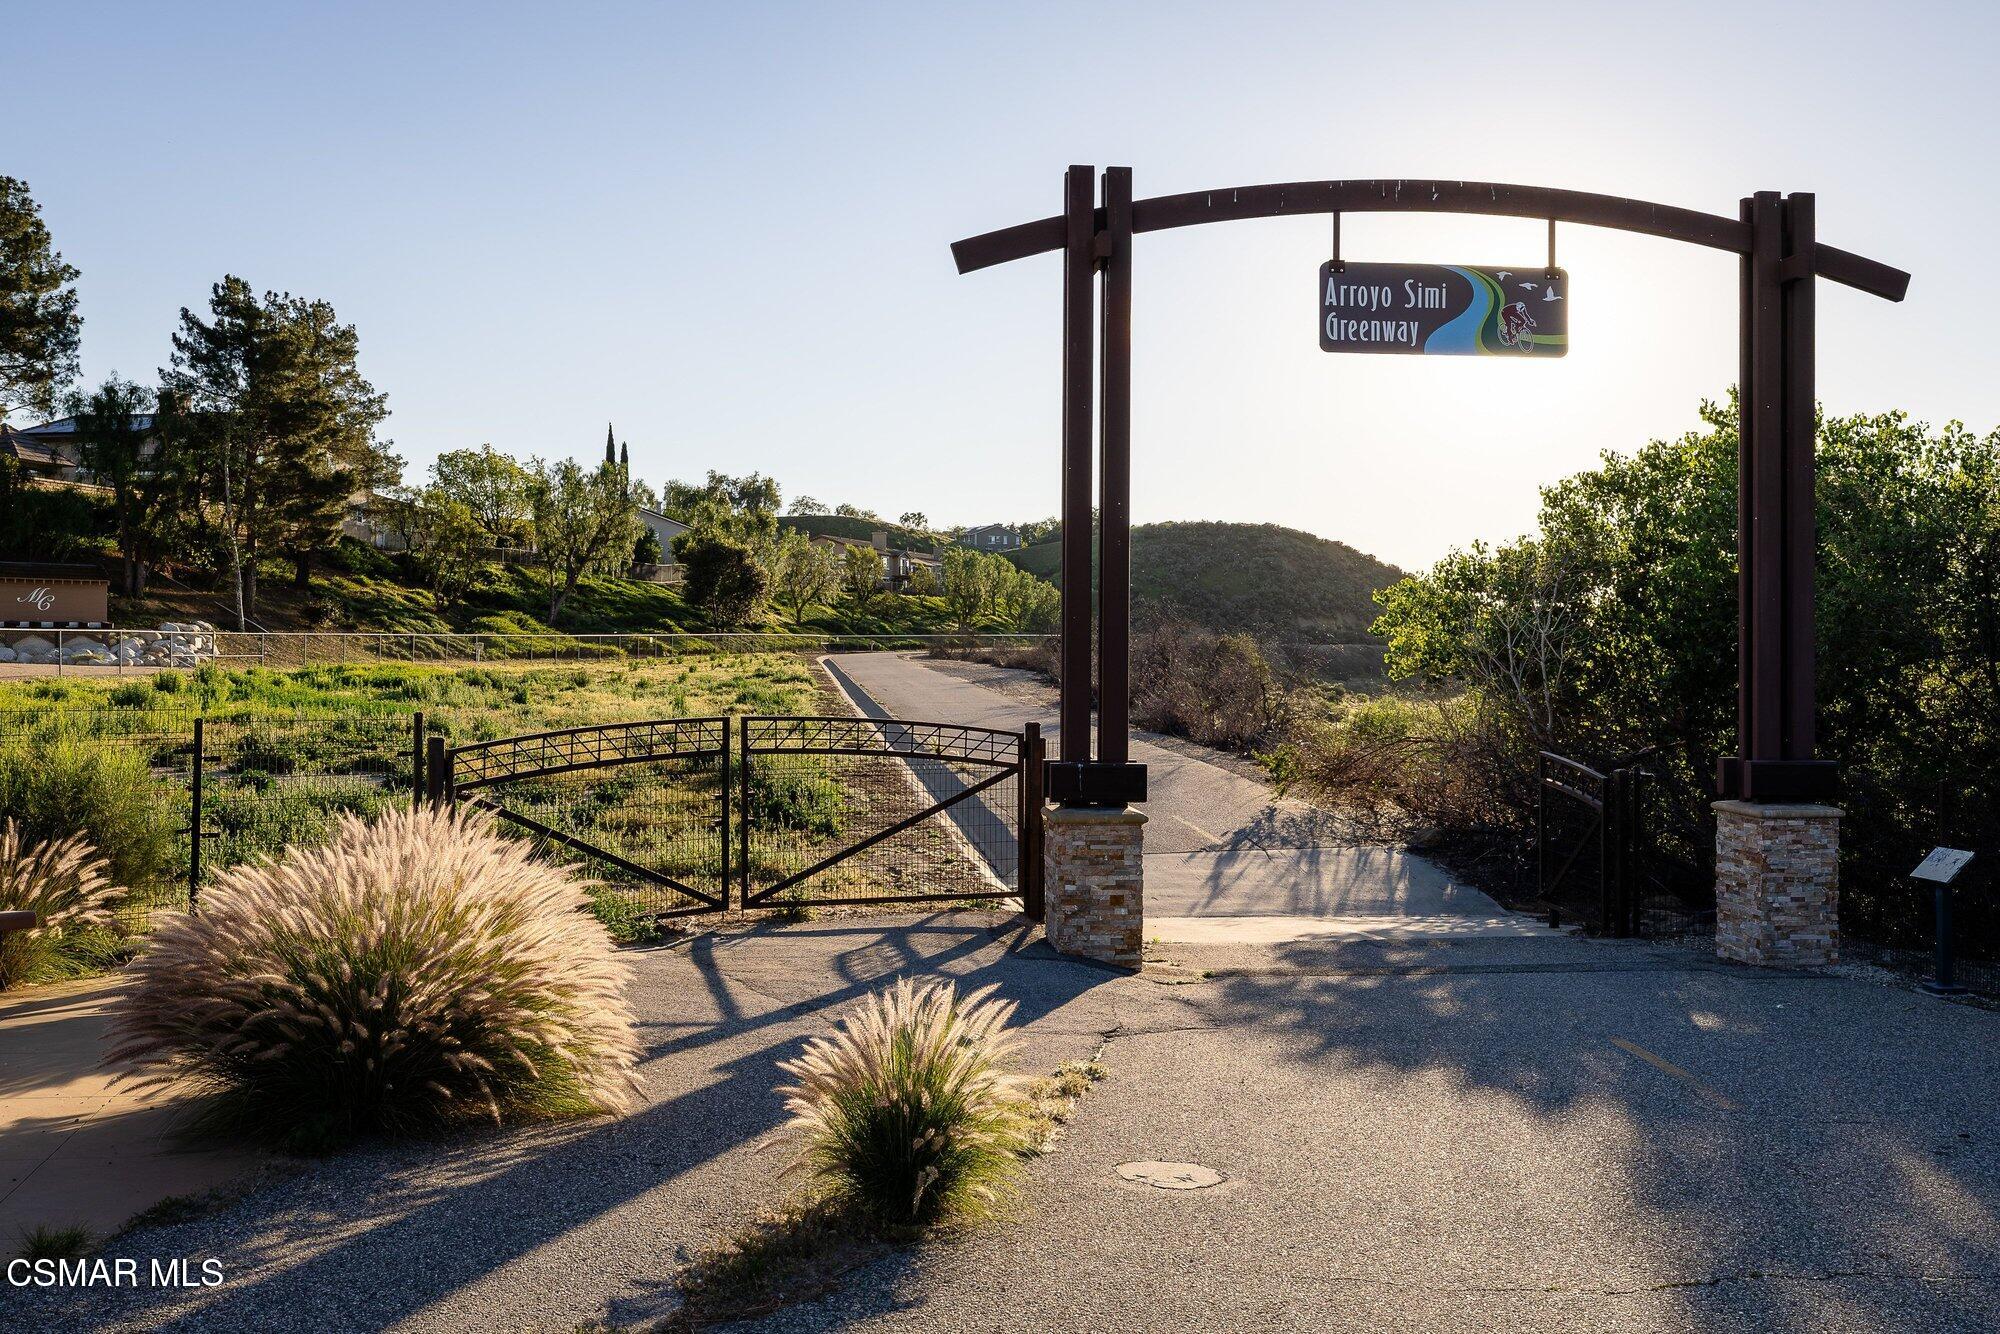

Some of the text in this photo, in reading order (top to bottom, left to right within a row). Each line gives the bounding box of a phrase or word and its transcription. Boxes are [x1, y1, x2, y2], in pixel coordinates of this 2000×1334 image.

[1325, 277, 1447, 312] Arroyo Simi
[1325, 312, 1419, 347] Greenway
